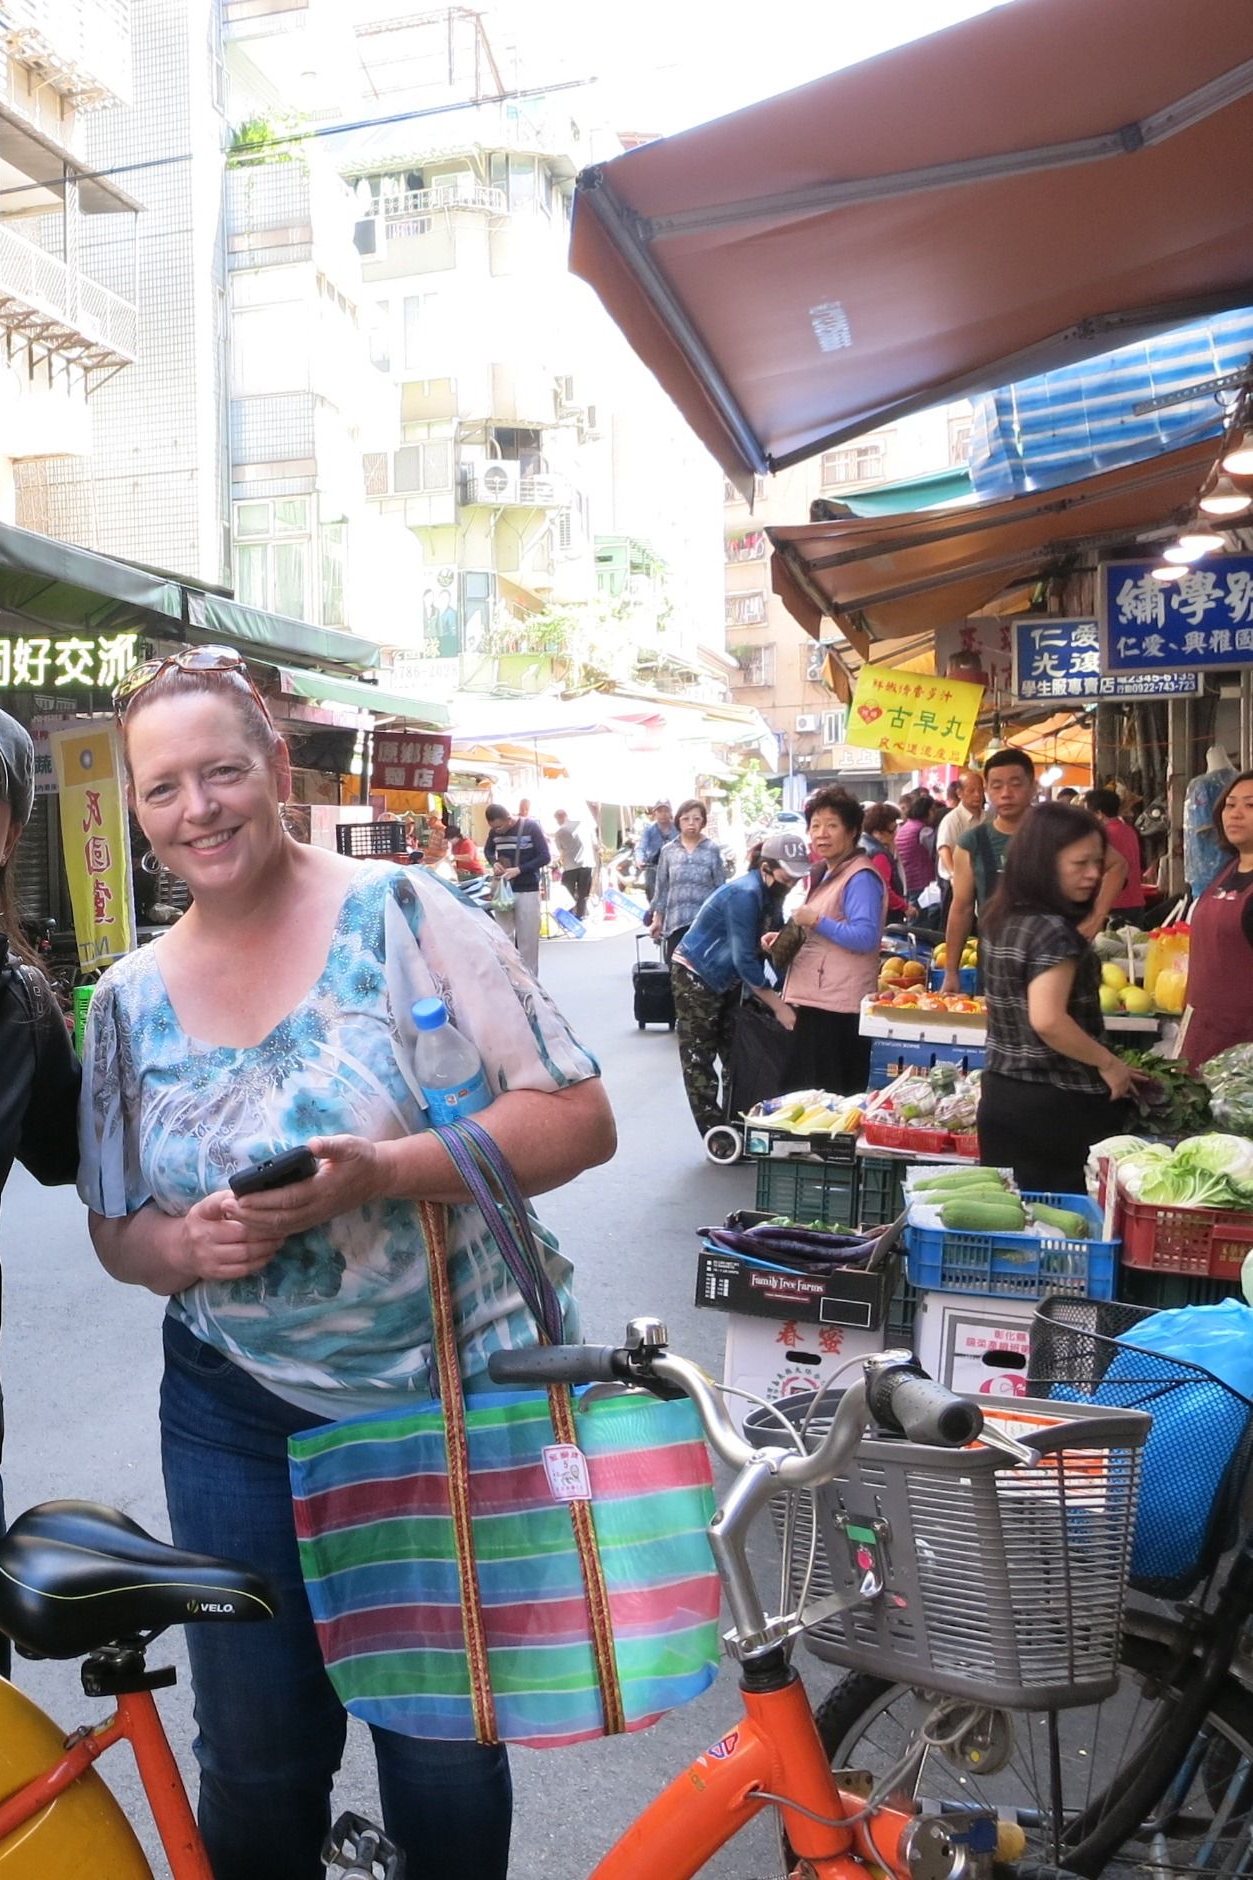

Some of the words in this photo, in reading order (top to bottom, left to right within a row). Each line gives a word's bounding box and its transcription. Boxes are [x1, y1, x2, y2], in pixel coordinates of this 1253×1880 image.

[1031, 623, 1099, 650] 仁愛
[1022, 677, 1114, 697] 學生服專賣店
[887, 706, 966, 741] 古早丸
[751, 1273, 778, 1289] Family
[779, 1277, 796, 1290] Tree
[797, 1280, 824, 1292] Farms
[200, 1603, 234, 1613] VELO
